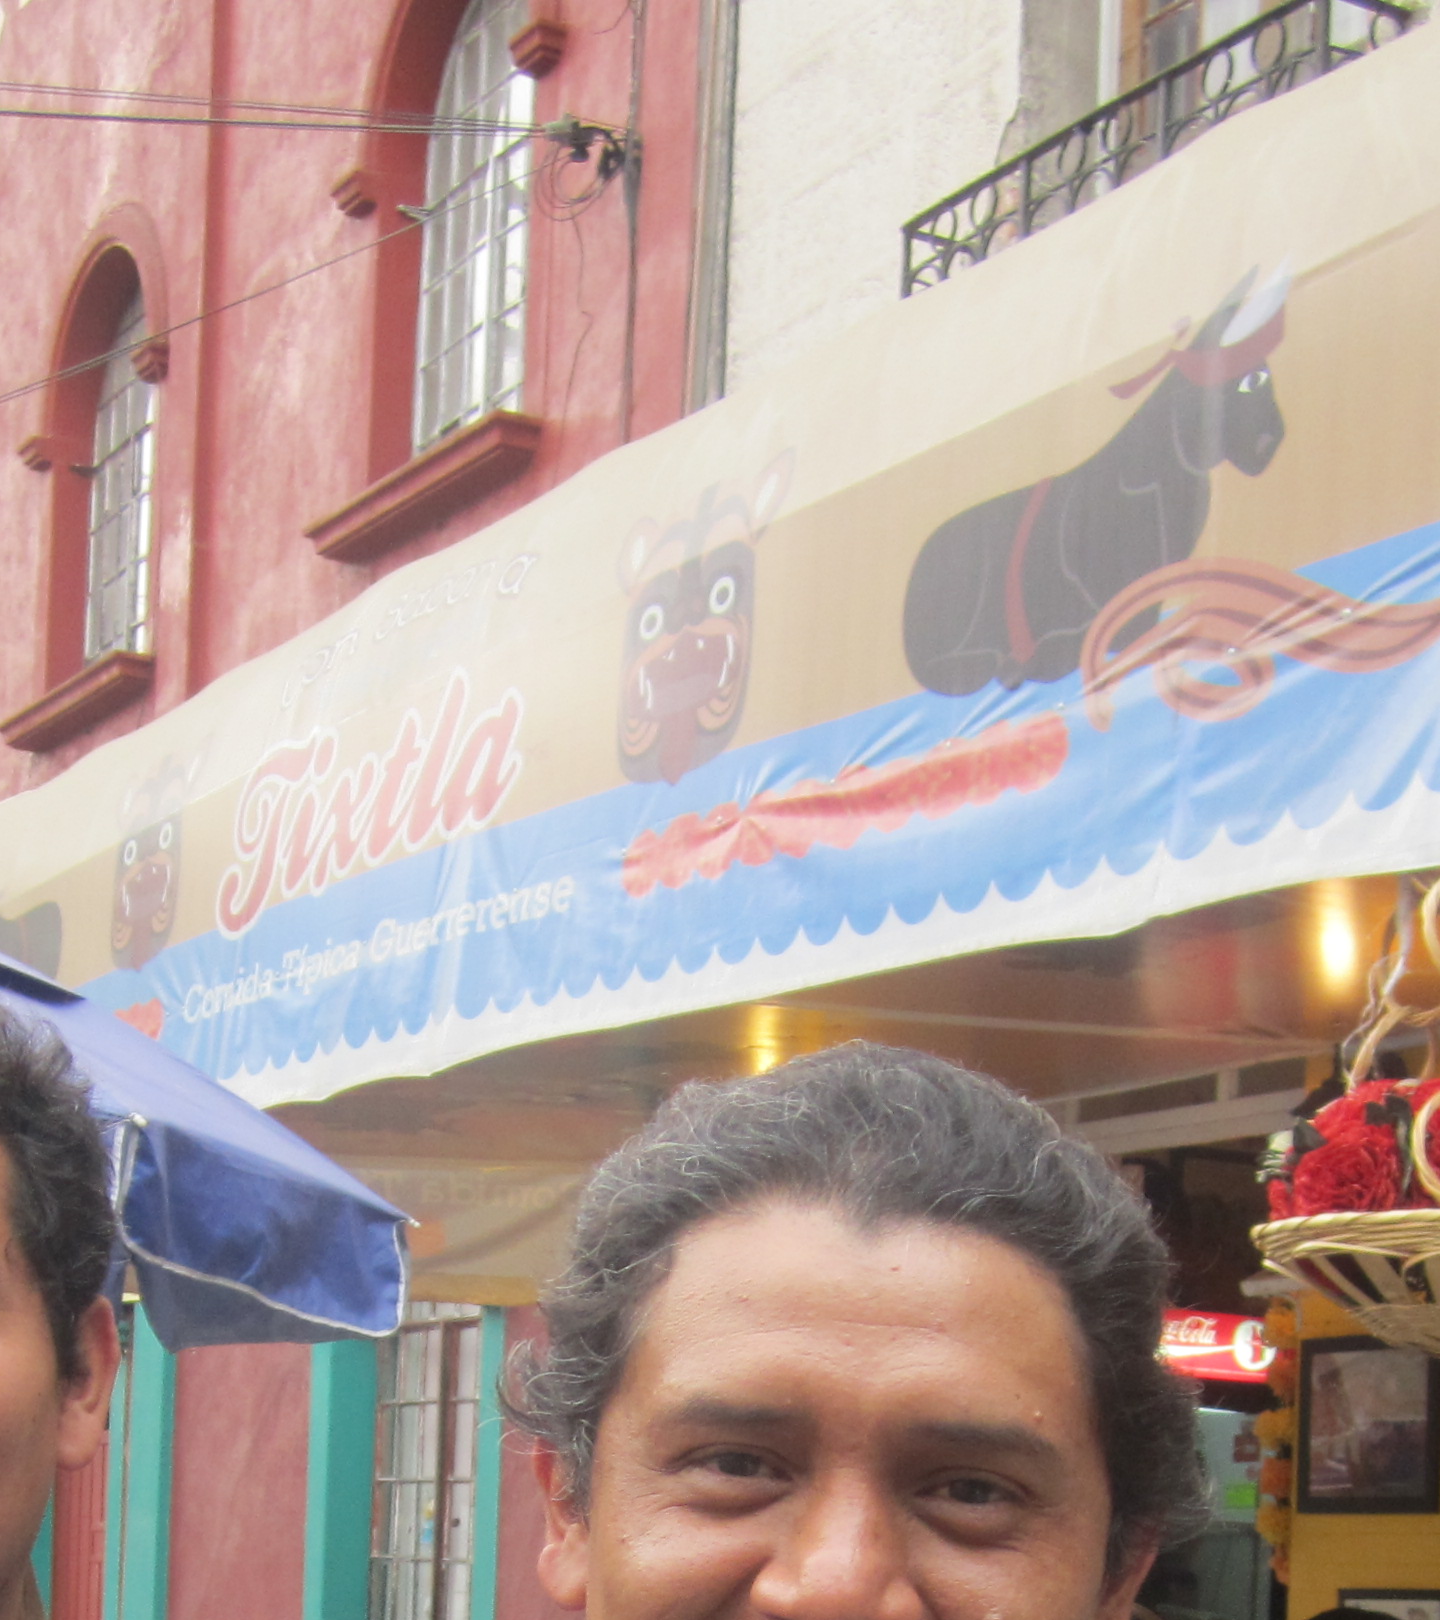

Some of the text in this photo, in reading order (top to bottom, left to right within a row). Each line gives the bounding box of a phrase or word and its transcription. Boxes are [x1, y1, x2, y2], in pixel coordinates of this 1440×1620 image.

[217, 666, 523, 940] Tixtla
[182, 875, 576, 1024] Comida Típica Guerrerense
